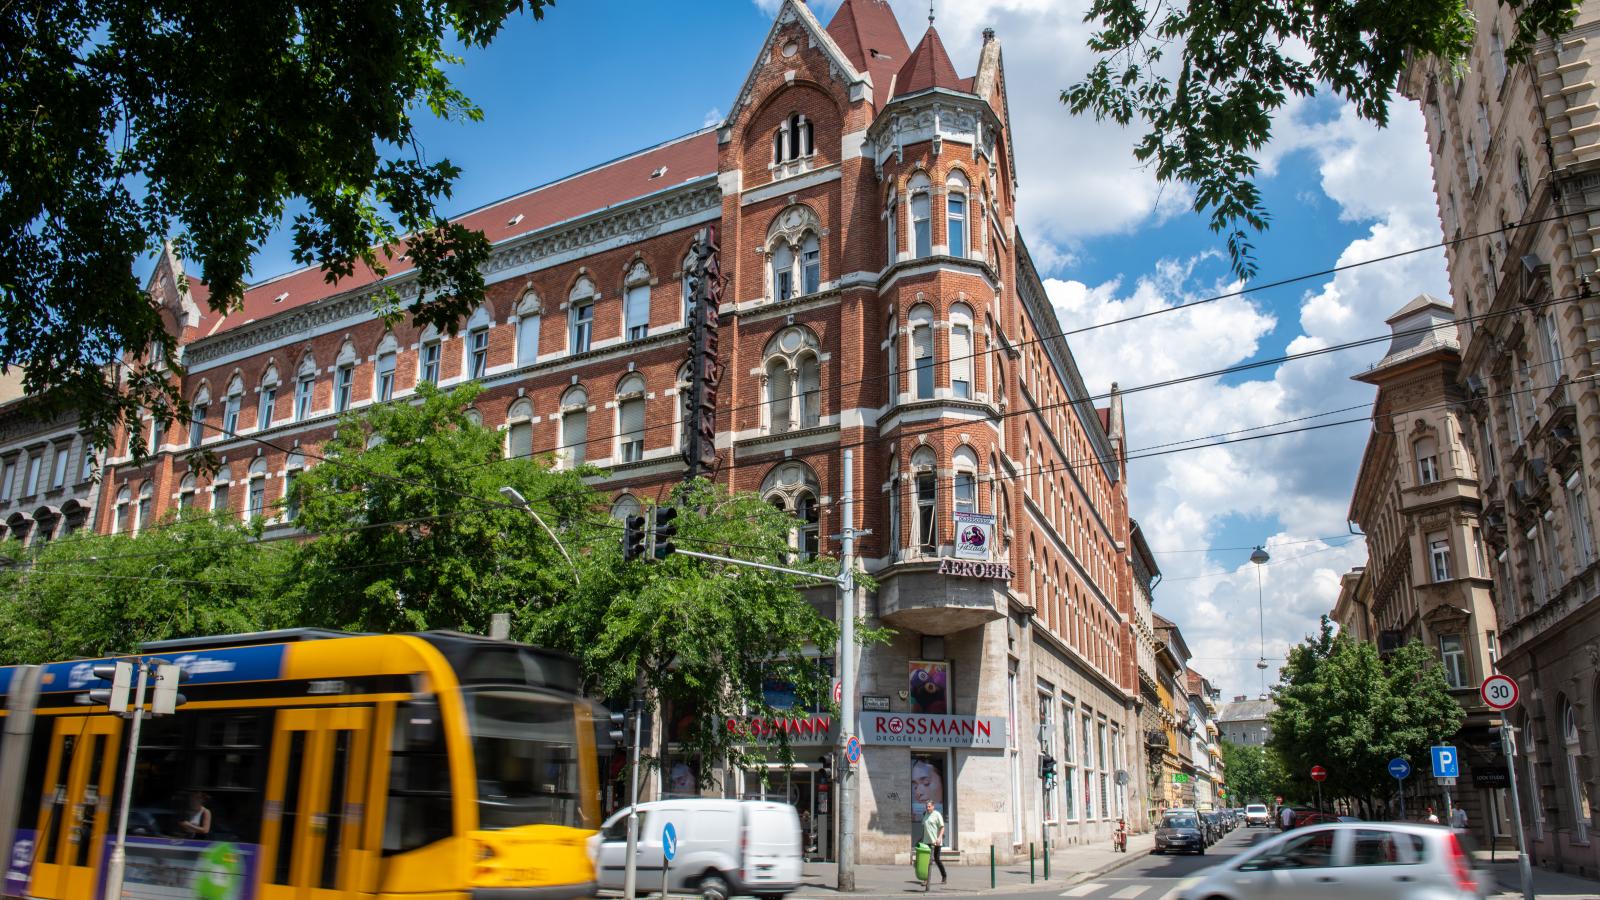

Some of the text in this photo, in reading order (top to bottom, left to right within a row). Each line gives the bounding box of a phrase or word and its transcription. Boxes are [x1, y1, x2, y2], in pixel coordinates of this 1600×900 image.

[957, 543, 987, 553] FitLady
[938, 560, 1012, 579] AEROBIK
[1490, 685, 1509, 699] 30
[875, 716, 991, 737] ROSSMANN
[1439, 751, 1453, 773] P
